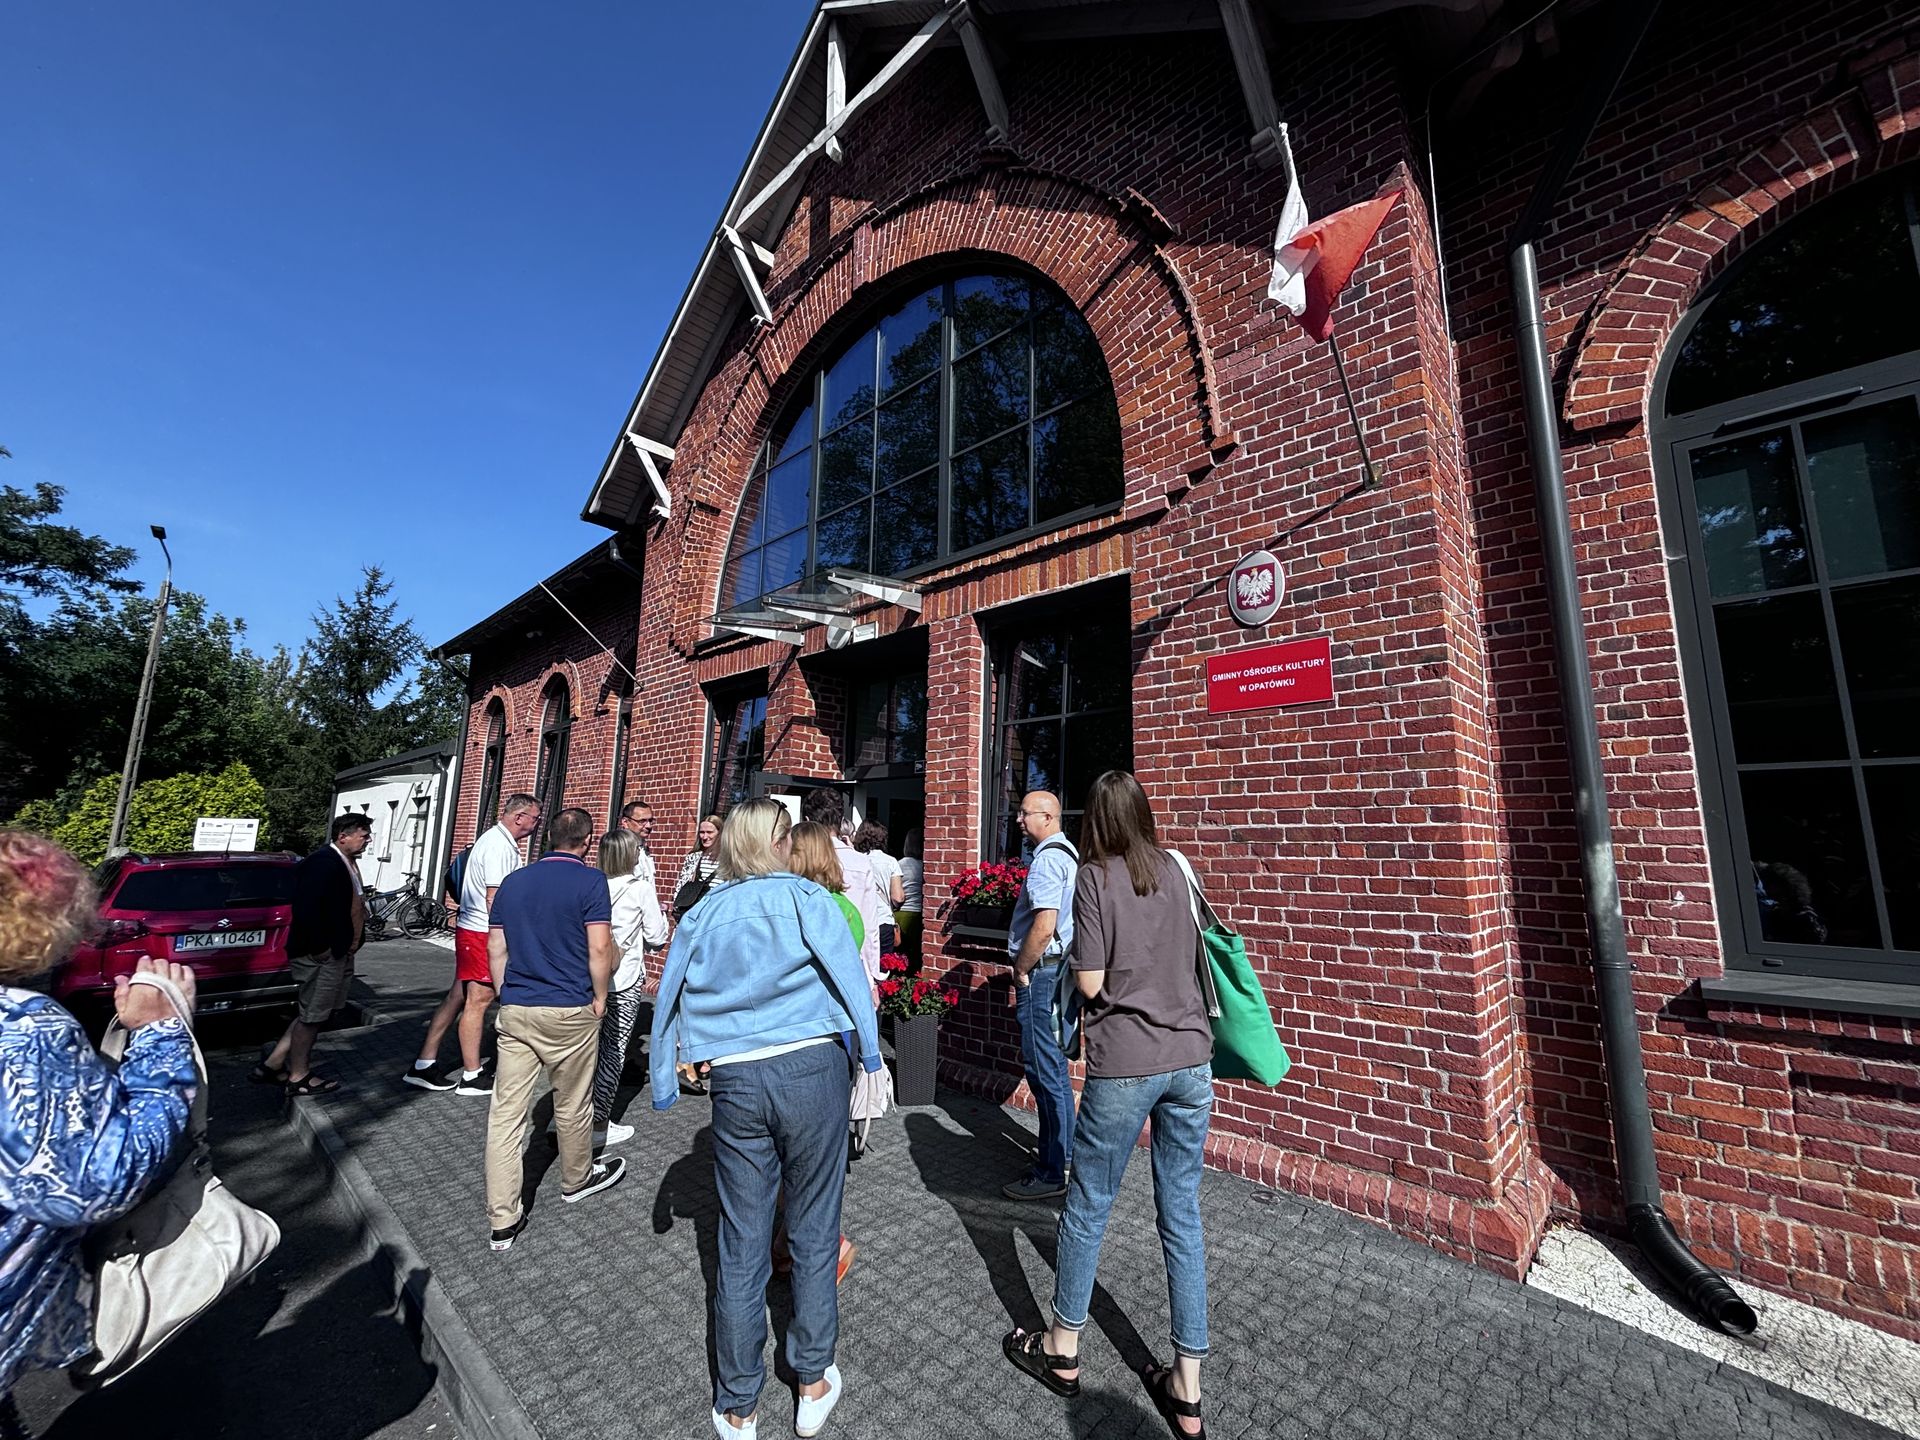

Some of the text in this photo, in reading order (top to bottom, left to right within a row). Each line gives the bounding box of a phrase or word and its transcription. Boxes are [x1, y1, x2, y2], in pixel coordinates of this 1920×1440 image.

[1212, 658, 1325, 682] GMINNY OŚRODEK KULTURY
[1248, 678, 1295, 691] OPATÓWKU
[184, 932, 262, 947] PKA 10461
